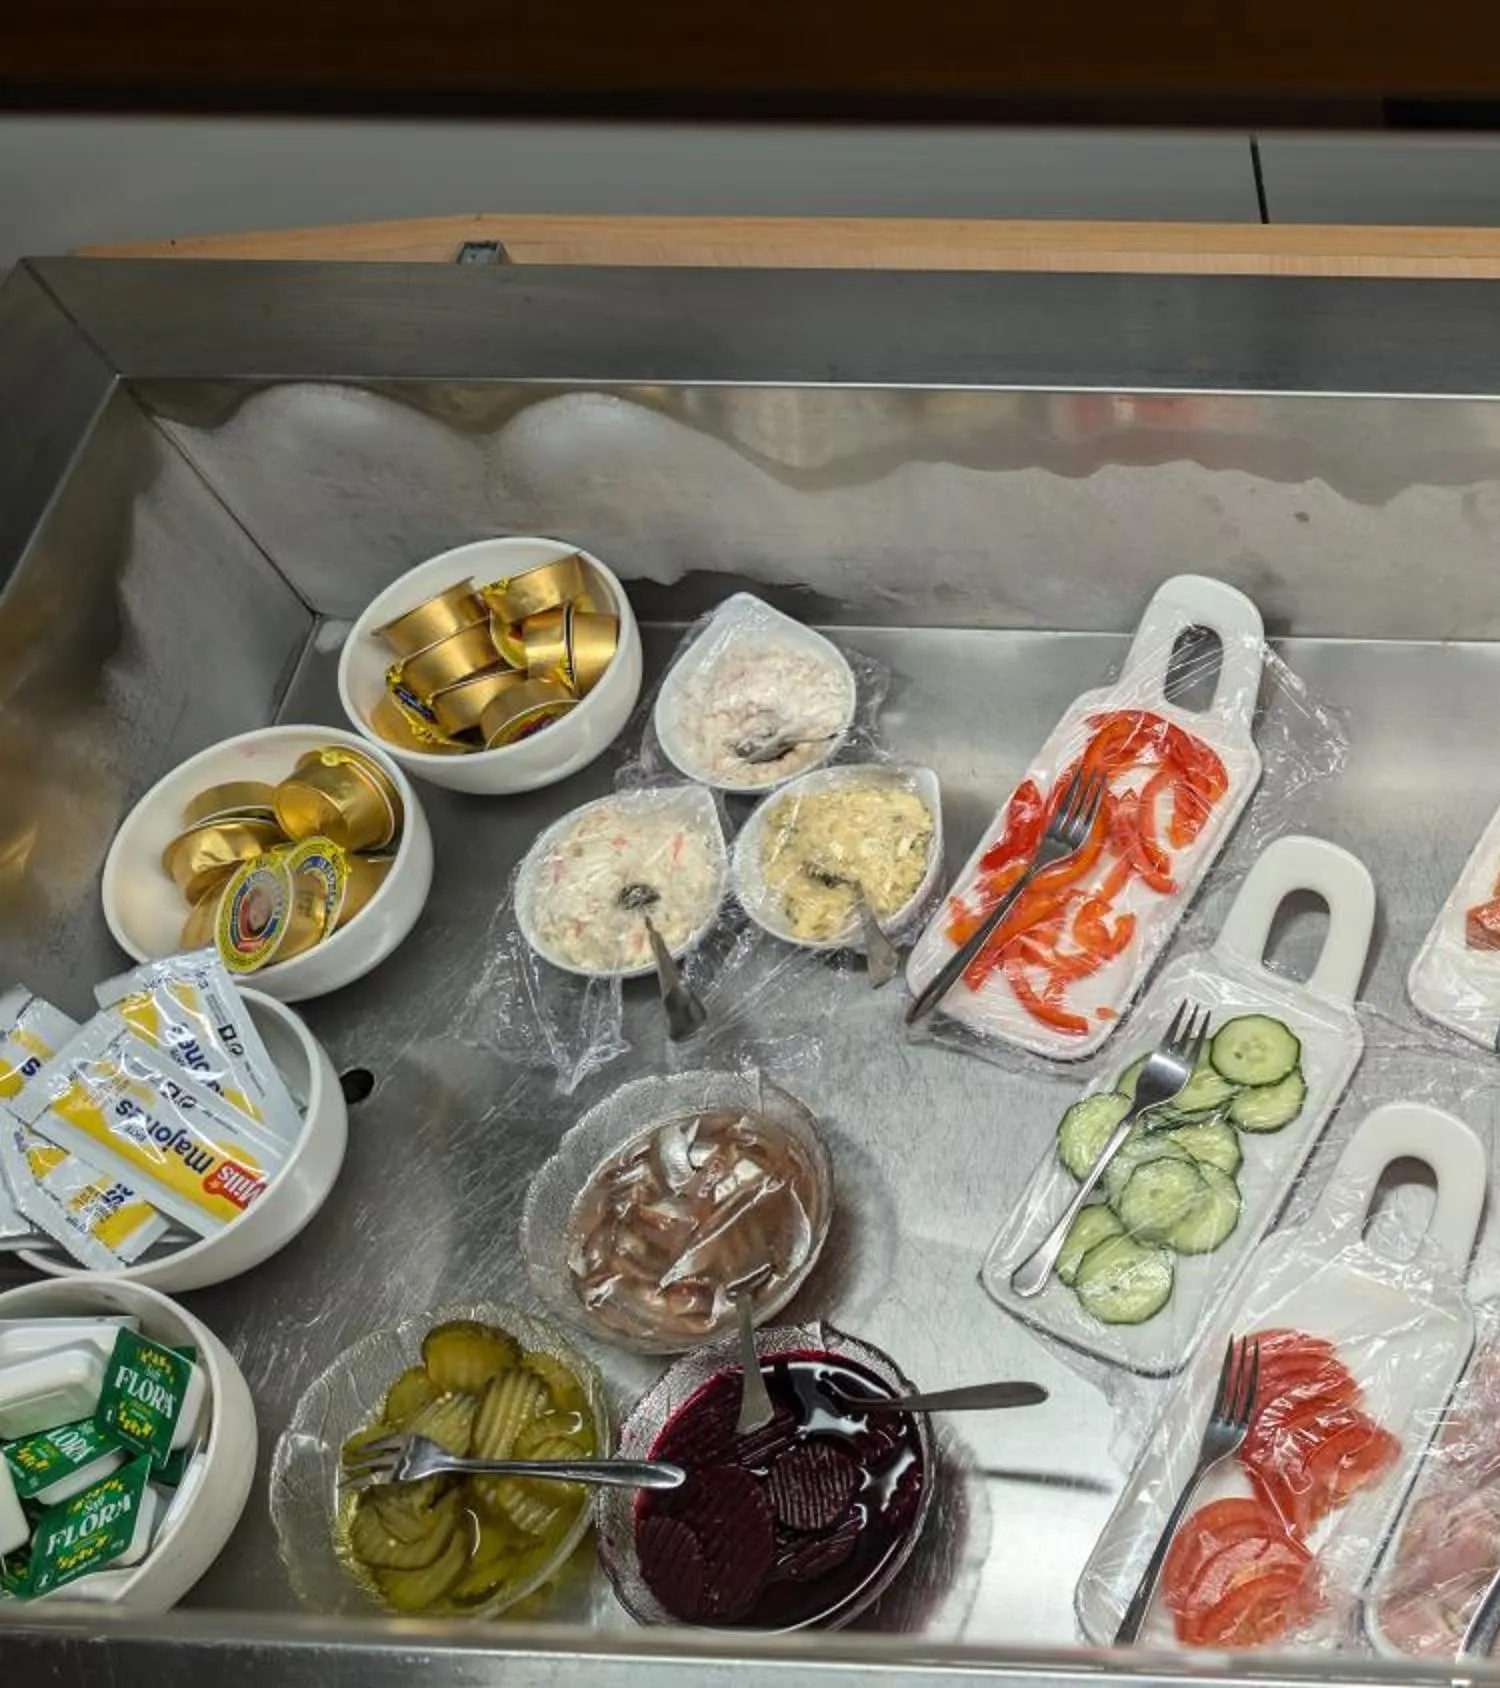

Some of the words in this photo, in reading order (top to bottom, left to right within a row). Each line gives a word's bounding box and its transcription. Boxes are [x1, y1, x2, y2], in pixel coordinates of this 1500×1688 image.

[114, 1364, 173, 1419] FLORA
[46, 1425, 95, 1464] LORA
[46, 1493, 132, 1557] FLORA
